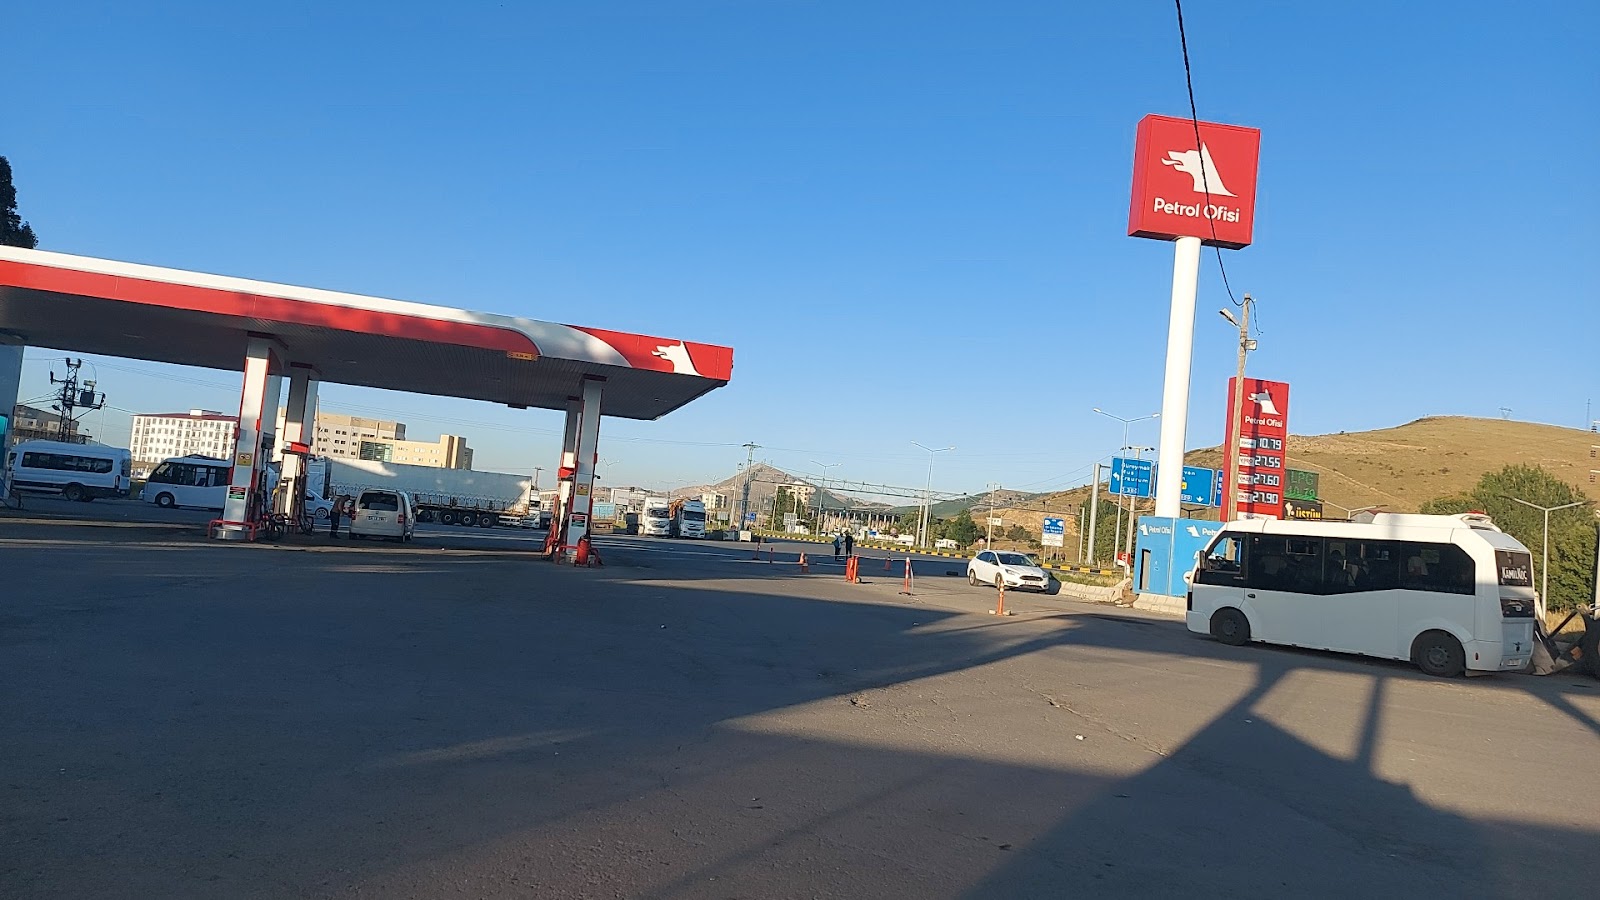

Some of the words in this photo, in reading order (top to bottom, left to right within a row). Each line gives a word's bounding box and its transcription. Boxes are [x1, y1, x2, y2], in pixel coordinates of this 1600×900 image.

[1153, 197, 1200, 217] Petrol
[1203, 204, 1240, 223] Ofisi
[1244, 415, 1265, 425] Petrol
[1266, 418, 1283, 428] Ofisi
[1259, 437, 1282, 450] 10.79
[1254, 455, 1281, 468] 27.55
[1253, 473, 1280, 486] 27.60
[1291, 471, 1314, 486] LPG
[1252, 491, 1279, 505] 27.90
